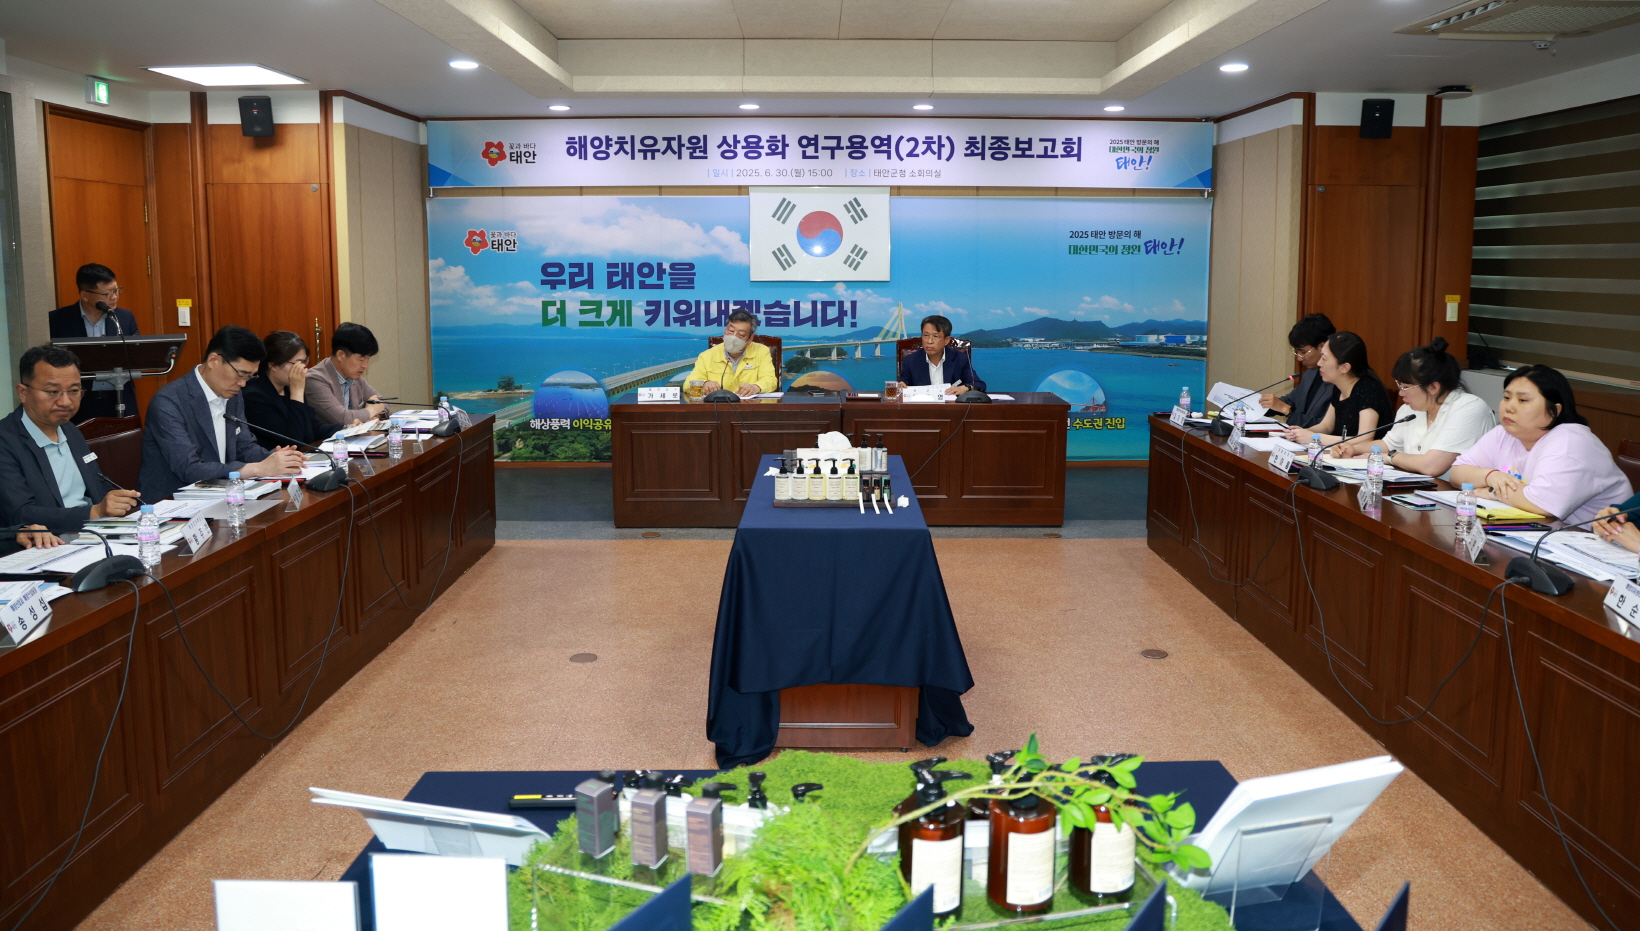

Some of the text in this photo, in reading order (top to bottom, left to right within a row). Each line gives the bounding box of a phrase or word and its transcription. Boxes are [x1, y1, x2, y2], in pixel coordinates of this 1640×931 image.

[565, 133, 1082, 162] 해양치유자원 상용화 연구용역(2차) 최종보고회
[1145, 146, 1160, 154] 정원
[509, 150, 537, 164] 태안
[1115, 155, 1153, 171] 태안!
[712, 168, 833, 178] 일시 2025. 6. 30.(월) 15:00
[849, 168, 942, 178] 장소 태안군청 소회의실
[1069, 230, 1142, 239] 2025 태안 방문의 해
[491, 239, 517, 252] 태안
[1068, 237, 1185, 255] 대한민국의 정원 태안!
[540, 261, 696, 290] 우리 태안을
[541, 300, 567, 327] 더
[578, 300, 633, 327] 크게
[529, 418, 612, 430] 해상풍력 이익공유
[1072, 417, 1103, 430] 수도권
[1104, 417, 1125, 429] 진입
